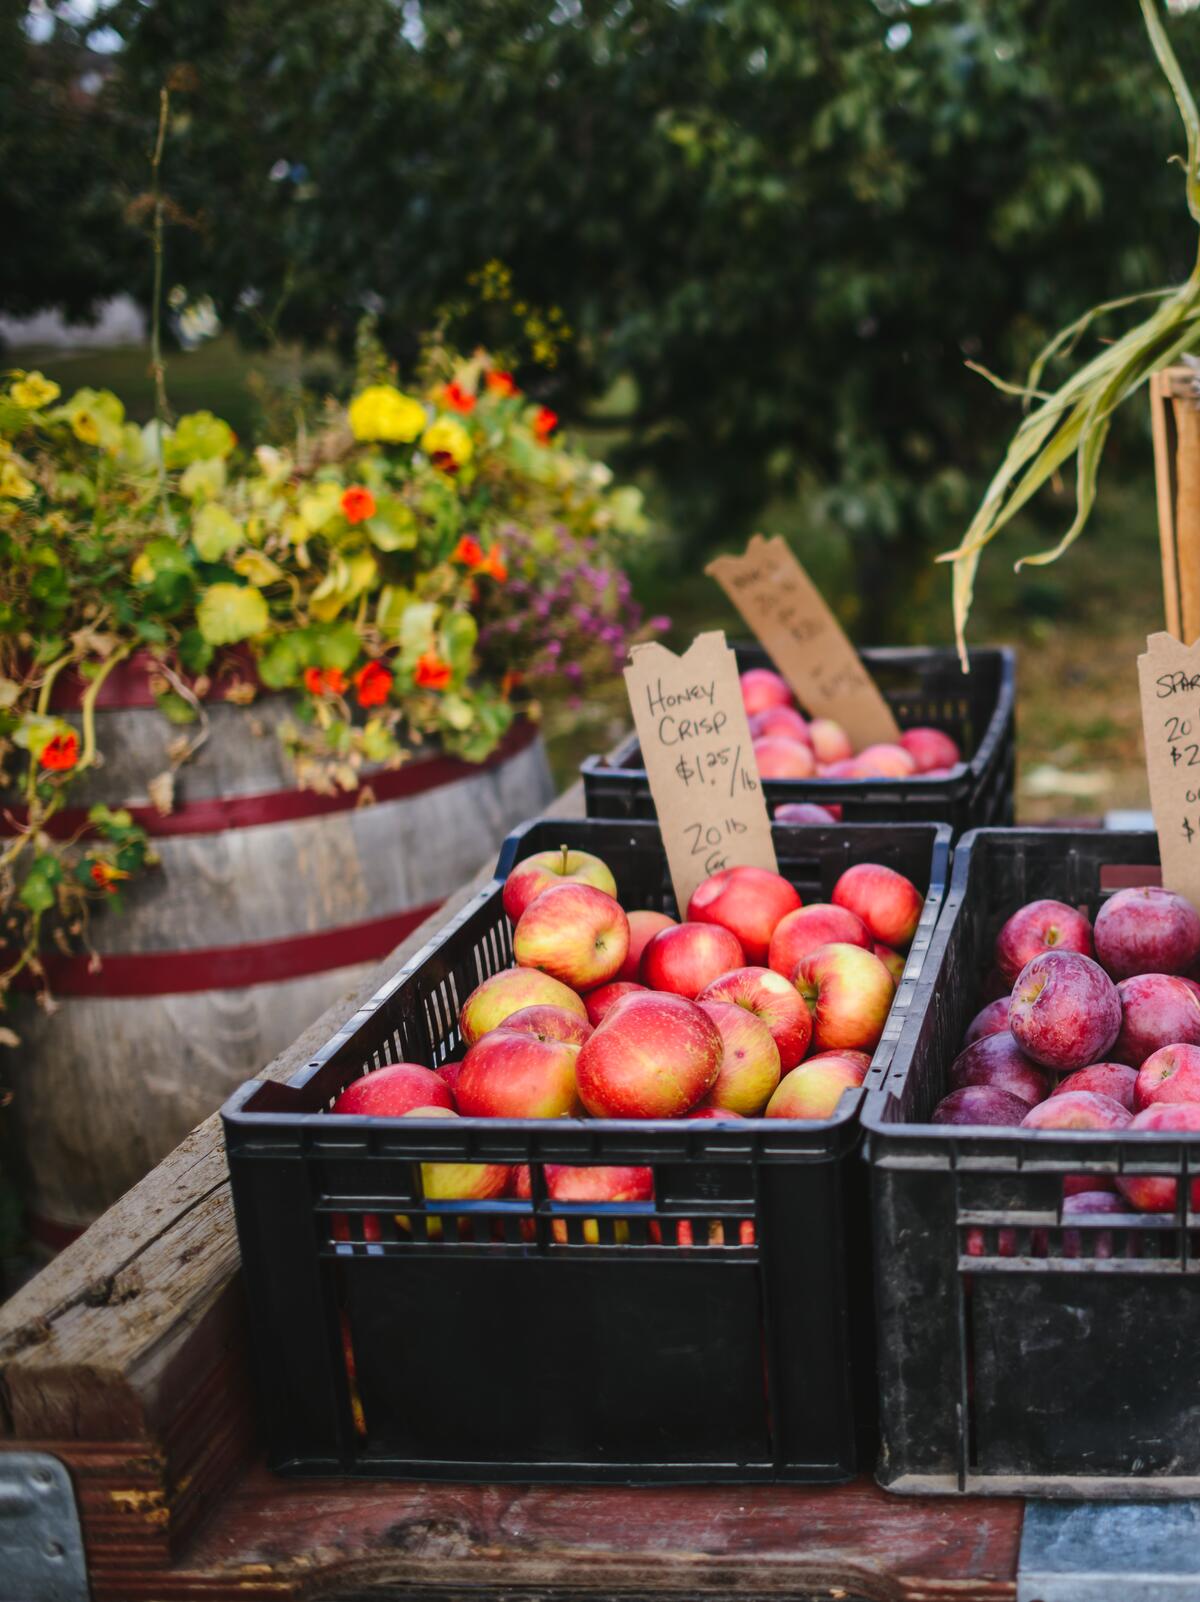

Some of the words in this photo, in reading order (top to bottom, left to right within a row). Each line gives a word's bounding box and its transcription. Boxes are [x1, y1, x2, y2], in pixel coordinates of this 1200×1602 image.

[658, 711, 728, 746] CRISP
[1164, 716, 1192, 743] 20
[684, 823, 721, 856] 20
[725, 818, 748, 835] lb
